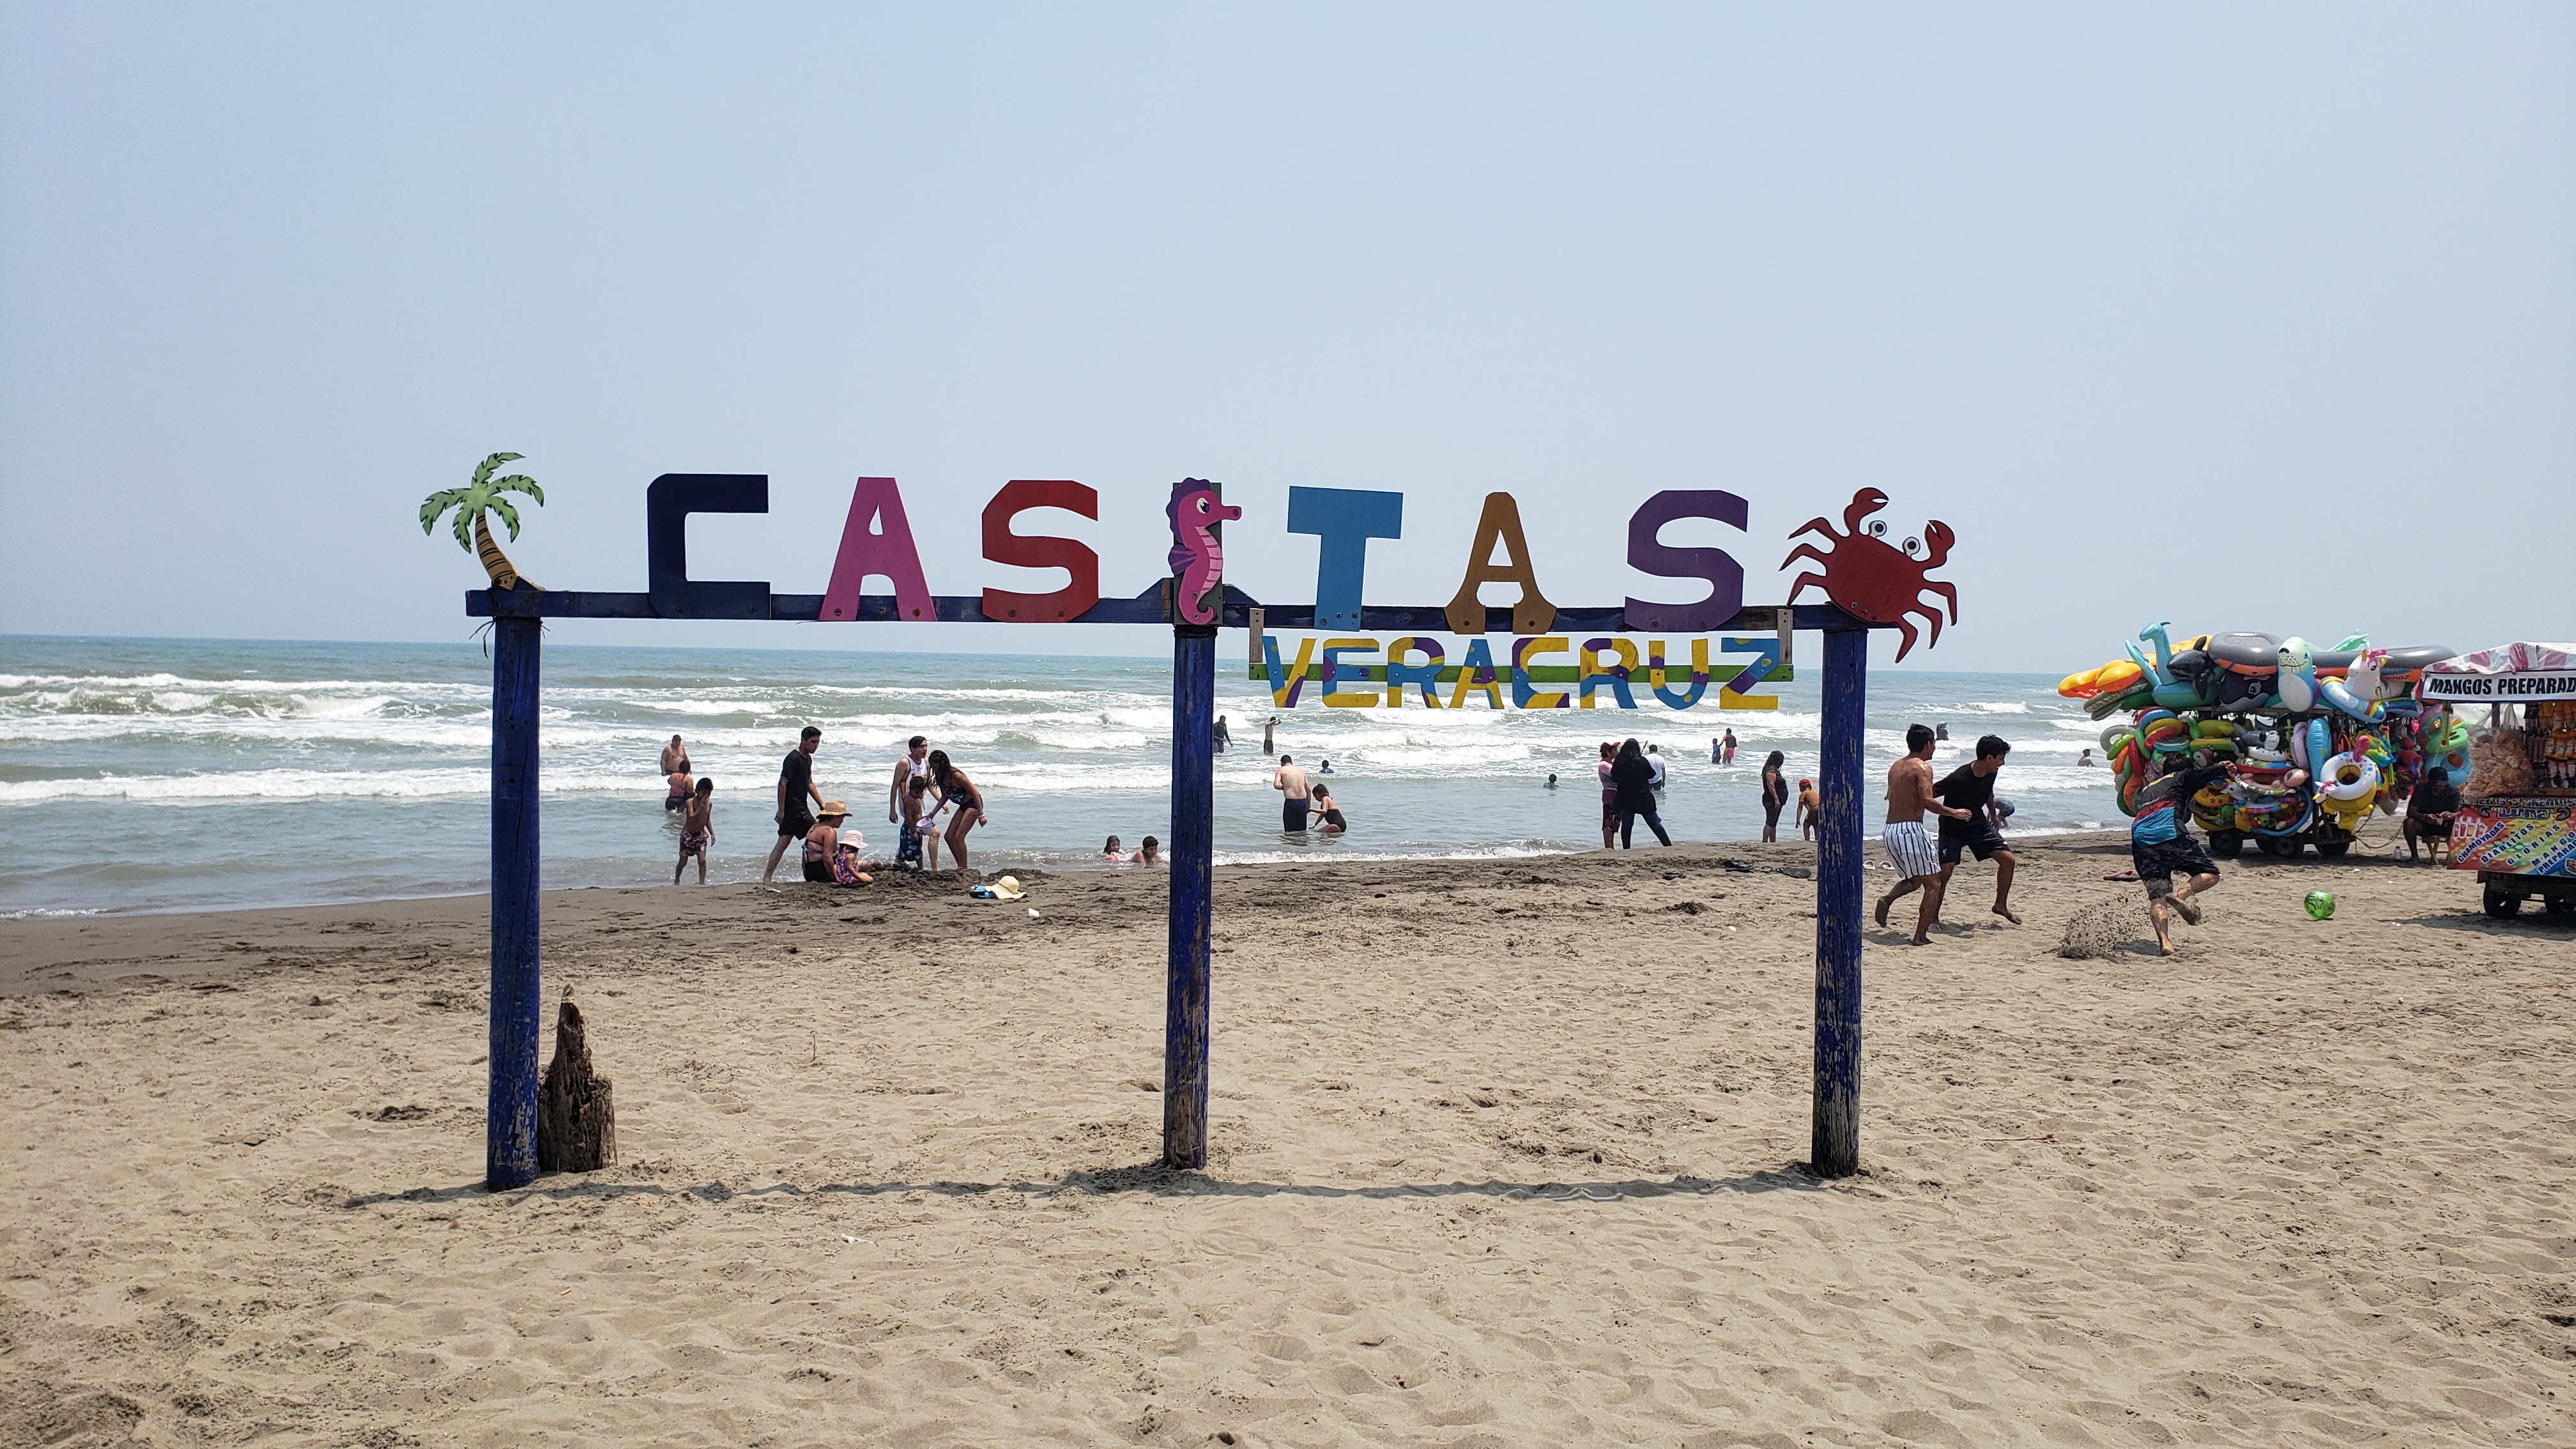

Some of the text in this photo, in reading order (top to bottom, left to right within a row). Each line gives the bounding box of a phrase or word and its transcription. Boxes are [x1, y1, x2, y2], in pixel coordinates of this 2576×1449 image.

[1262, 635, 1779, 710] VERACRUZ
[2428, 677, 2576, 694] MANGOS PREPARAD
[2458, 822, 2505, 863] CHAMOYADAS
[2481, 824, 2534, 863] DIABLITOS
[2508, 825, 2561, 864] GLORIAS
[2531, 831, 2575, 866] MANGO
